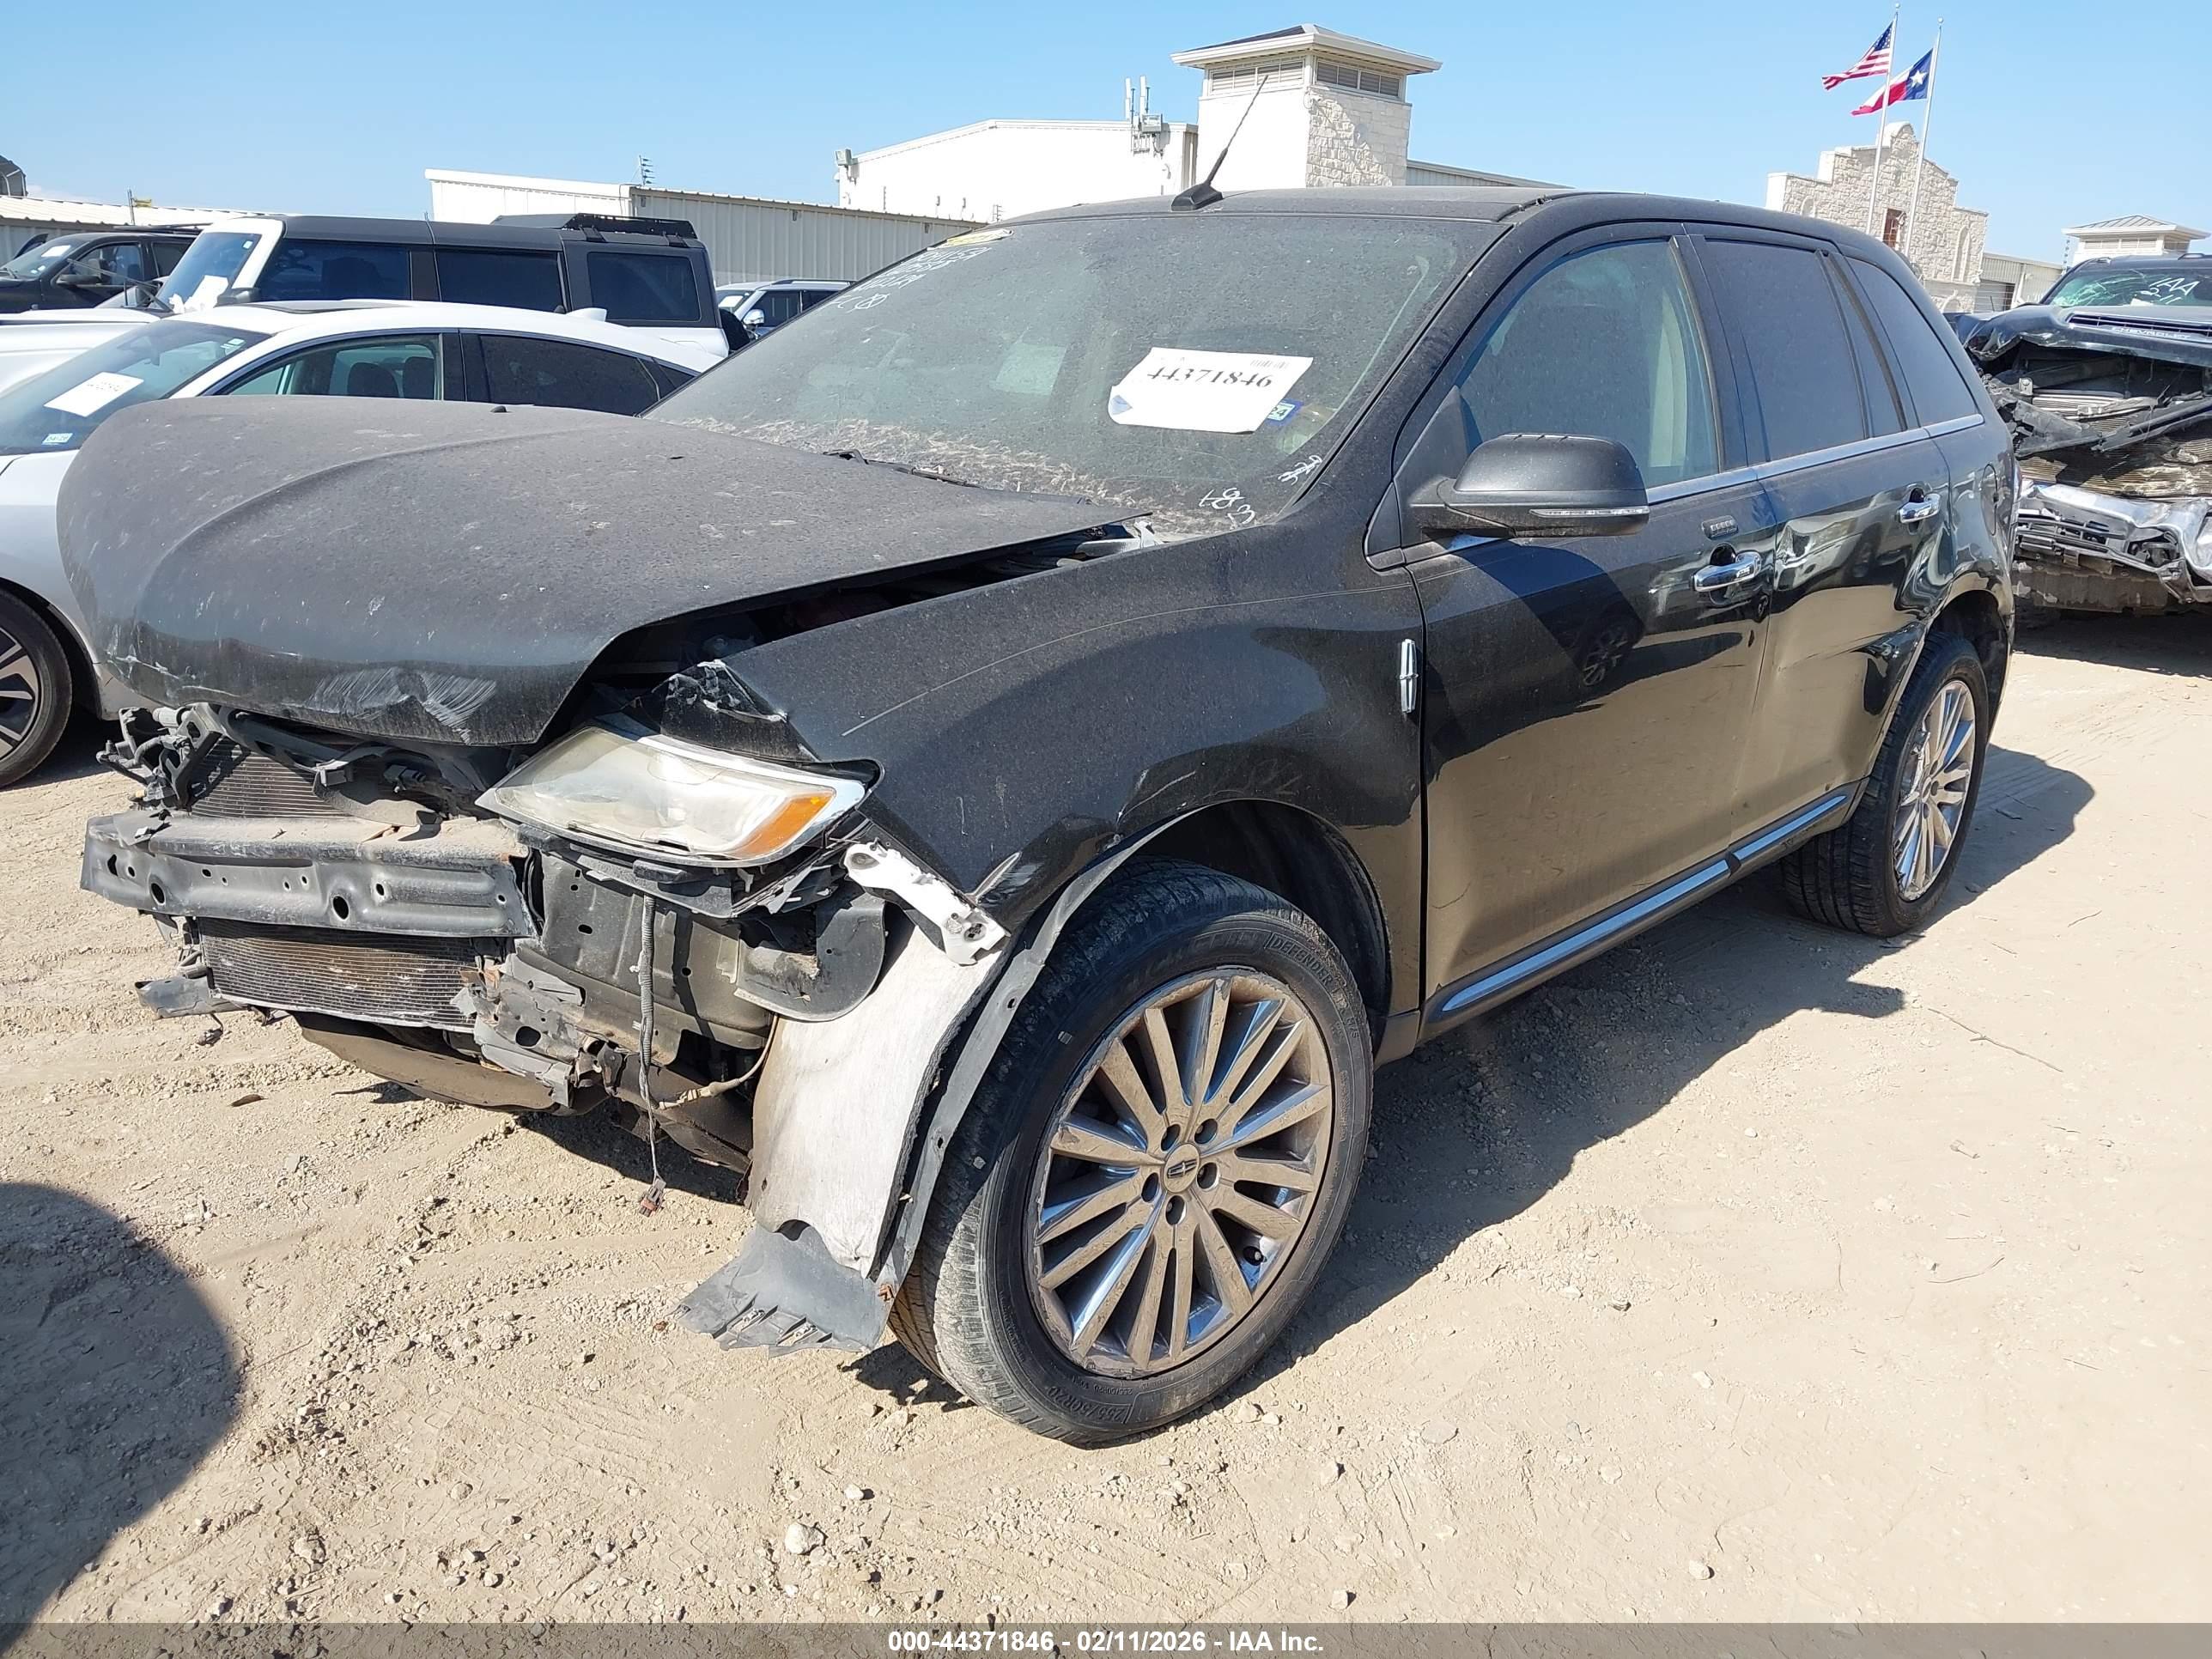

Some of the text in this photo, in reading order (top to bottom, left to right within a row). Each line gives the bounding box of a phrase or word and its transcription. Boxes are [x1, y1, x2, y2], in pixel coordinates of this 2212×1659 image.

[1147, 367, 1273, 387] 44371846
[1271, 933, 1333, 986] DEFENDER
[1046, 1386, 1125, 1422] 255/50R20
